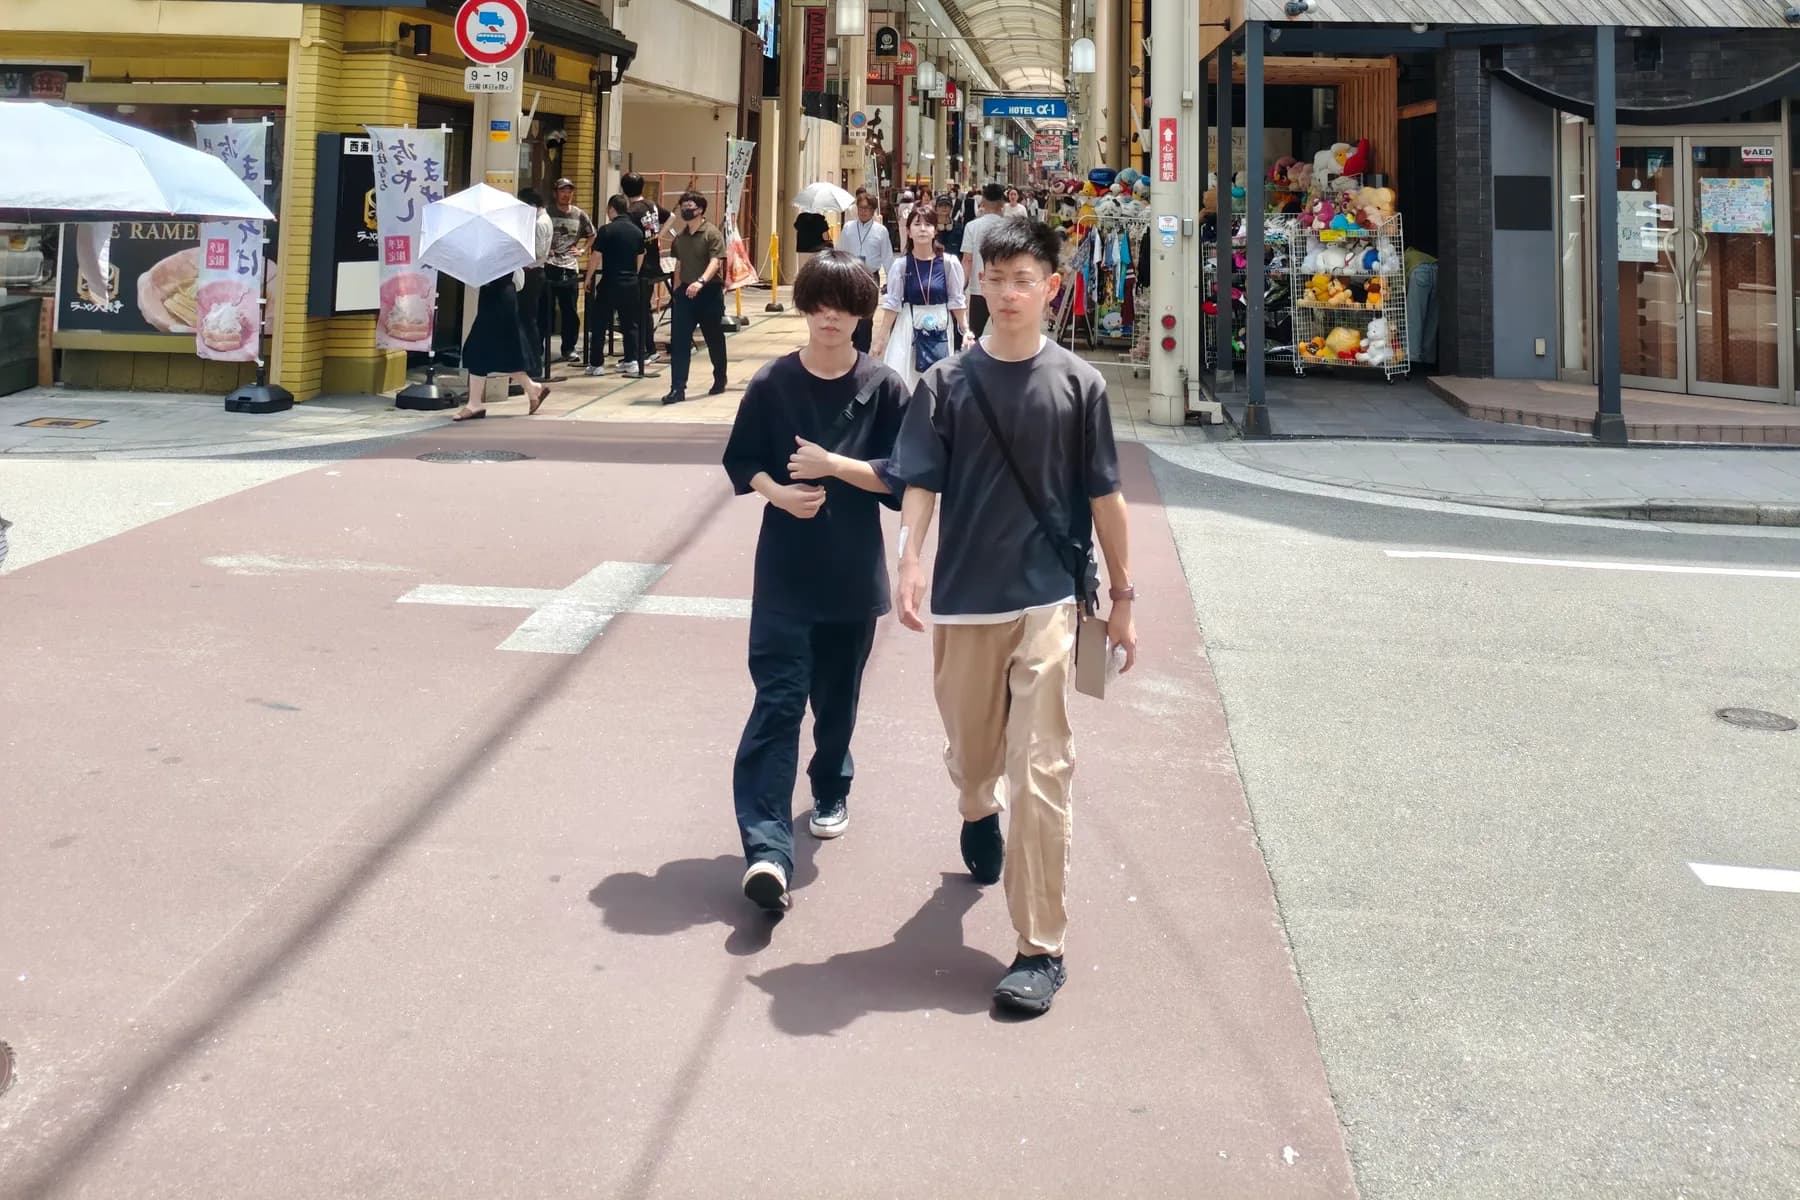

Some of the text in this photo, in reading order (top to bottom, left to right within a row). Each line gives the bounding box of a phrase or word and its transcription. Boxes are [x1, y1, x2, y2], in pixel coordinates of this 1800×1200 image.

[1008, 105, 1035, 115] HOTEL
[350, 140, 375, 153] 西海
[1752, 148, 1773, 156] AED
